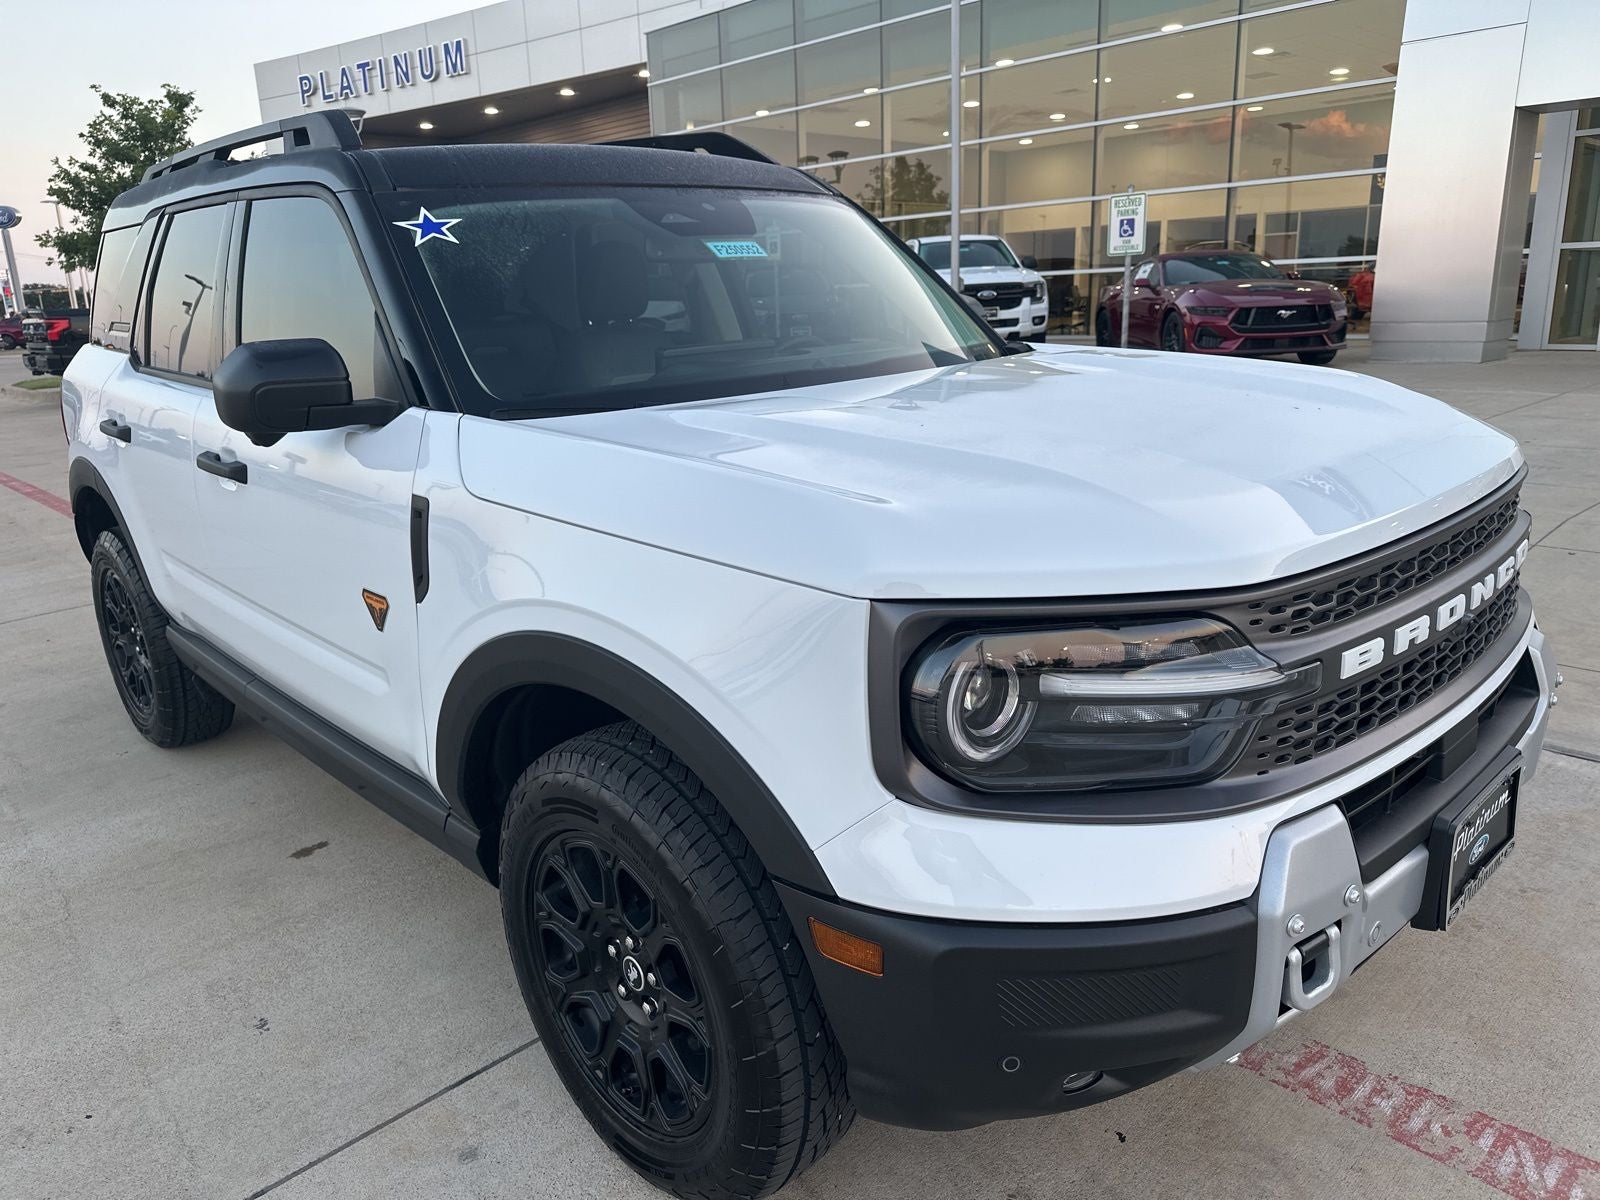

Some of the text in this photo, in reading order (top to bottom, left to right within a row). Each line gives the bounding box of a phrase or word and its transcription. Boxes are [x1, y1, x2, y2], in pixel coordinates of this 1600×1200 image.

[298, 38, 467, 106] PLATINUM
[1114, 197, 1142, 208] RESERVED
[1117, 207, 1138, 217] PARKING
[713, 244, 764, 255] F250552
[1340, 539, 1529, 680] BRONCO
[1454, 790, 1511, 862] Platinum
